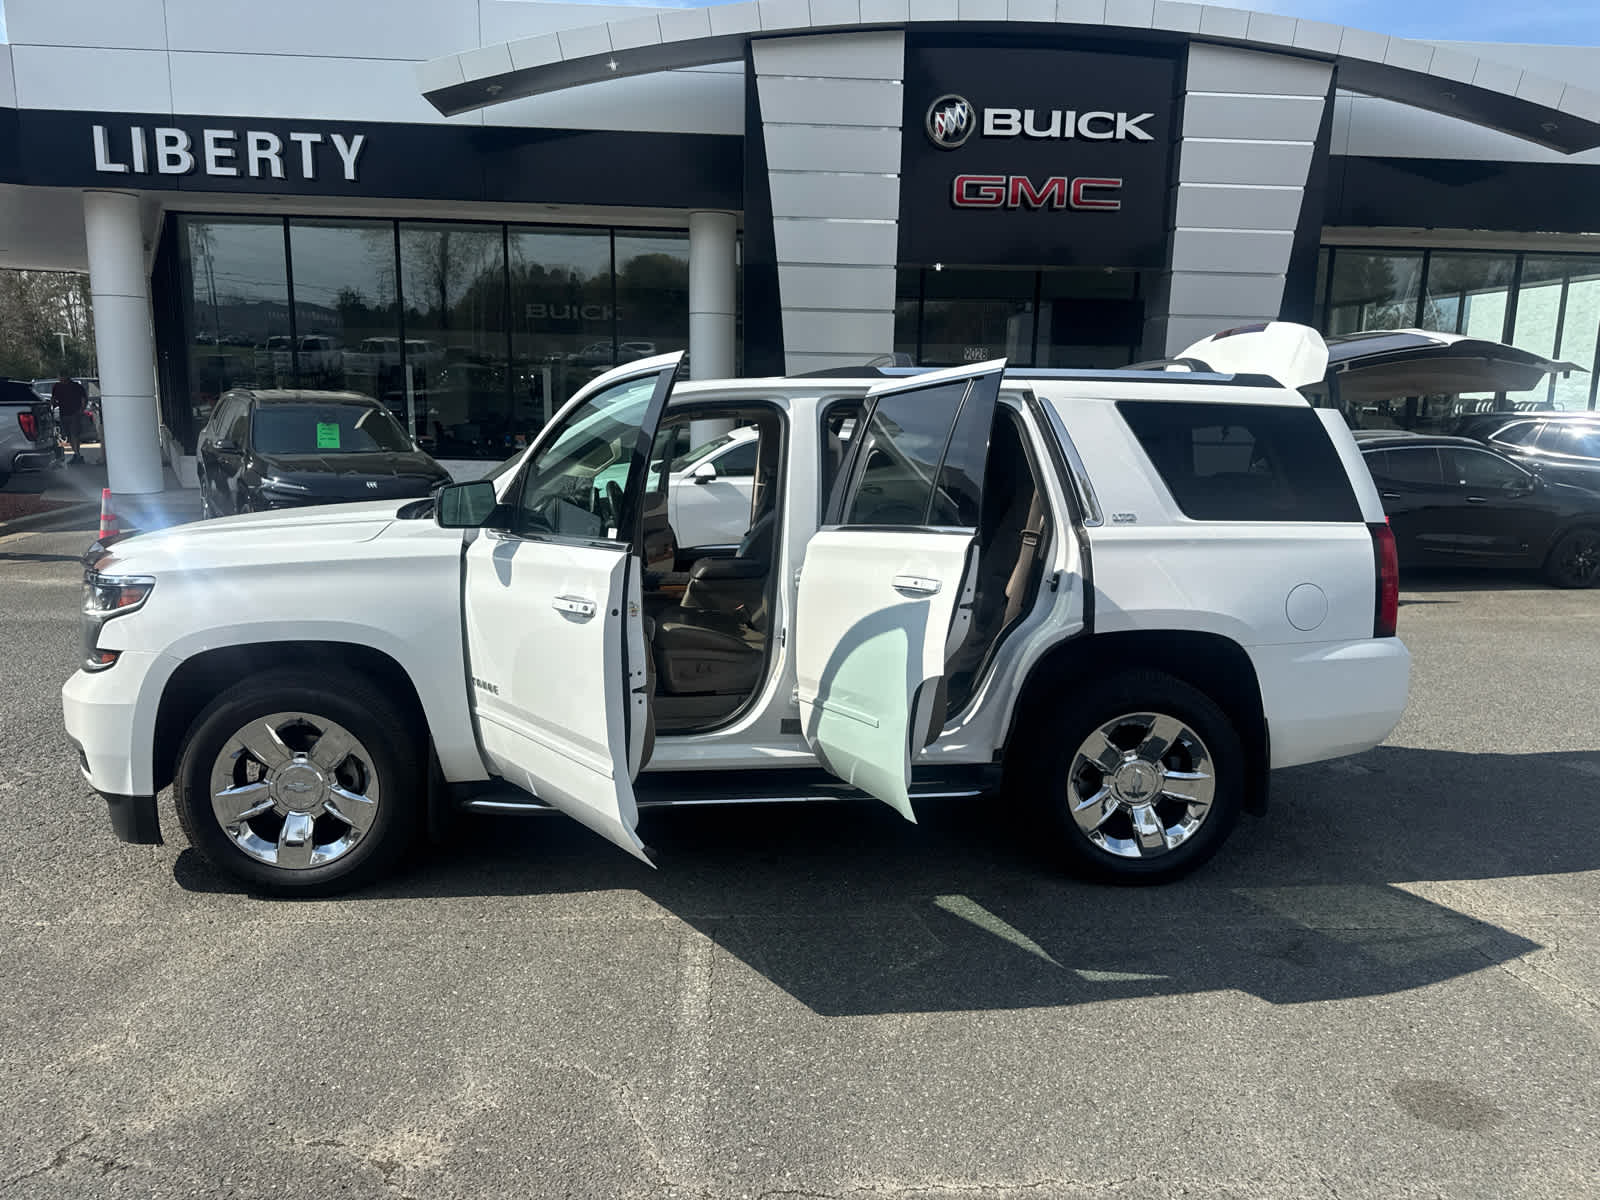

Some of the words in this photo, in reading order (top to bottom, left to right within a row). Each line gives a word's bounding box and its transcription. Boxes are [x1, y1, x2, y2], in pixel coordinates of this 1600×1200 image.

[983, 108, 1156, 140] BUICK
[92, 124, 365, 181] LIBERTY
[953, 174, 1123, 209] GMC
